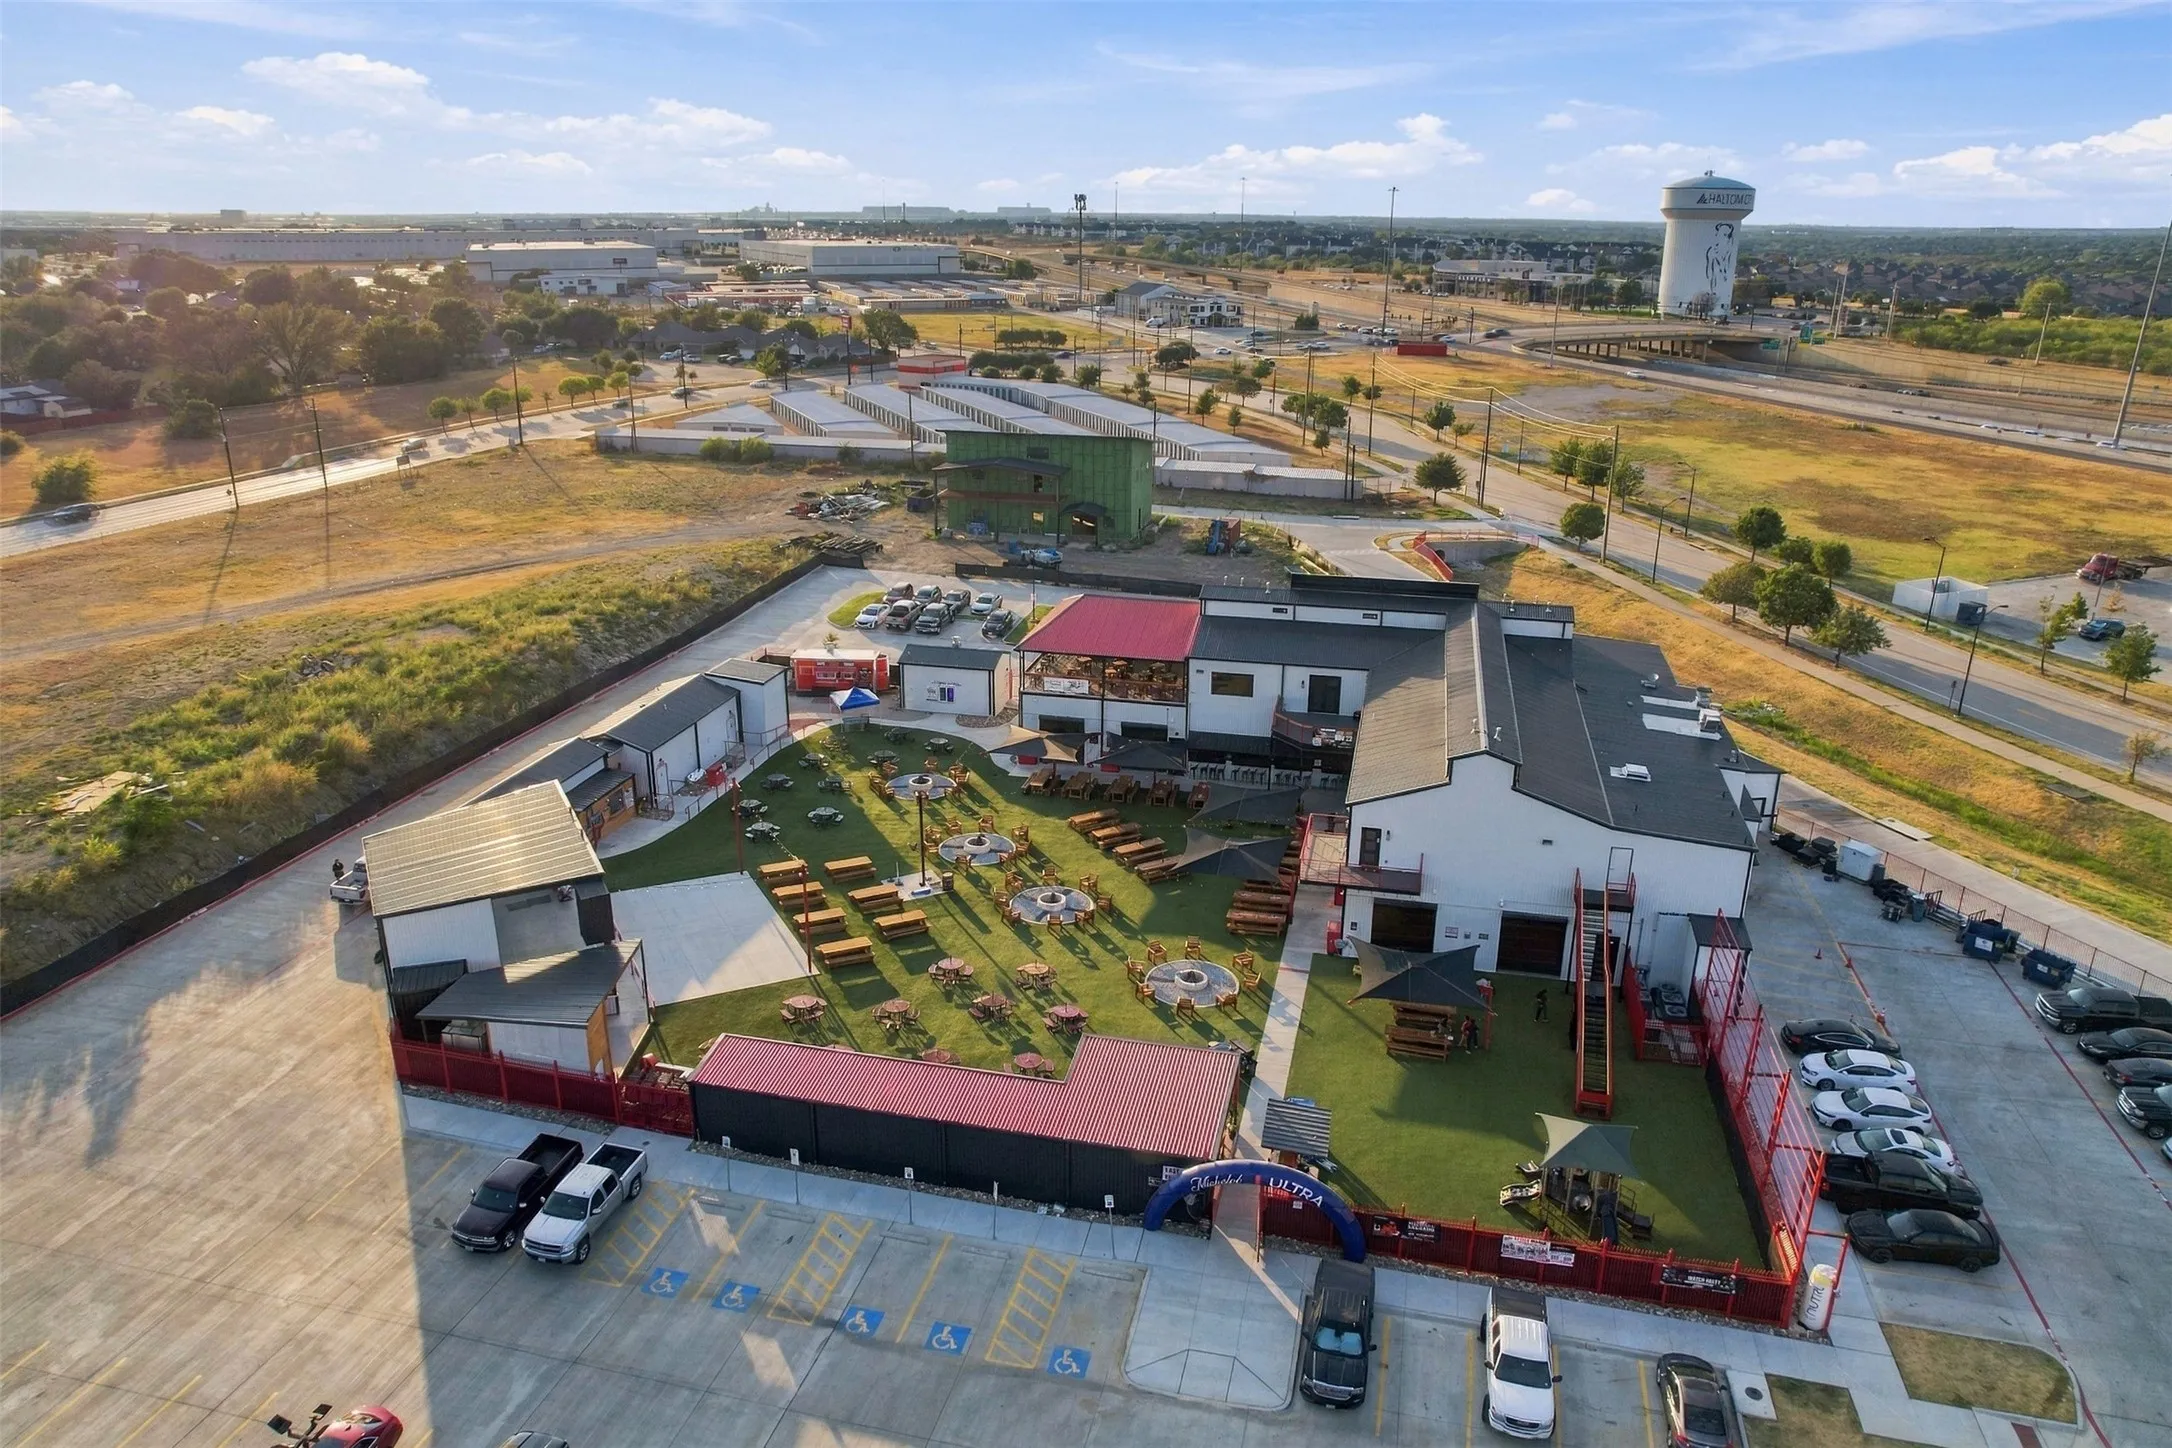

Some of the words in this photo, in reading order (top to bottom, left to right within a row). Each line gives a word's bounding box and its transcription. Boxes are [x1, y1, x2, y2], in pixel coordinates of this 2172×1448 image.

[1708, 193, 1744, 205] HALTOM
[1191, 1174, 1243, 1192] Michelob
[1269, 1177, 1324, 1207] ULTRA
